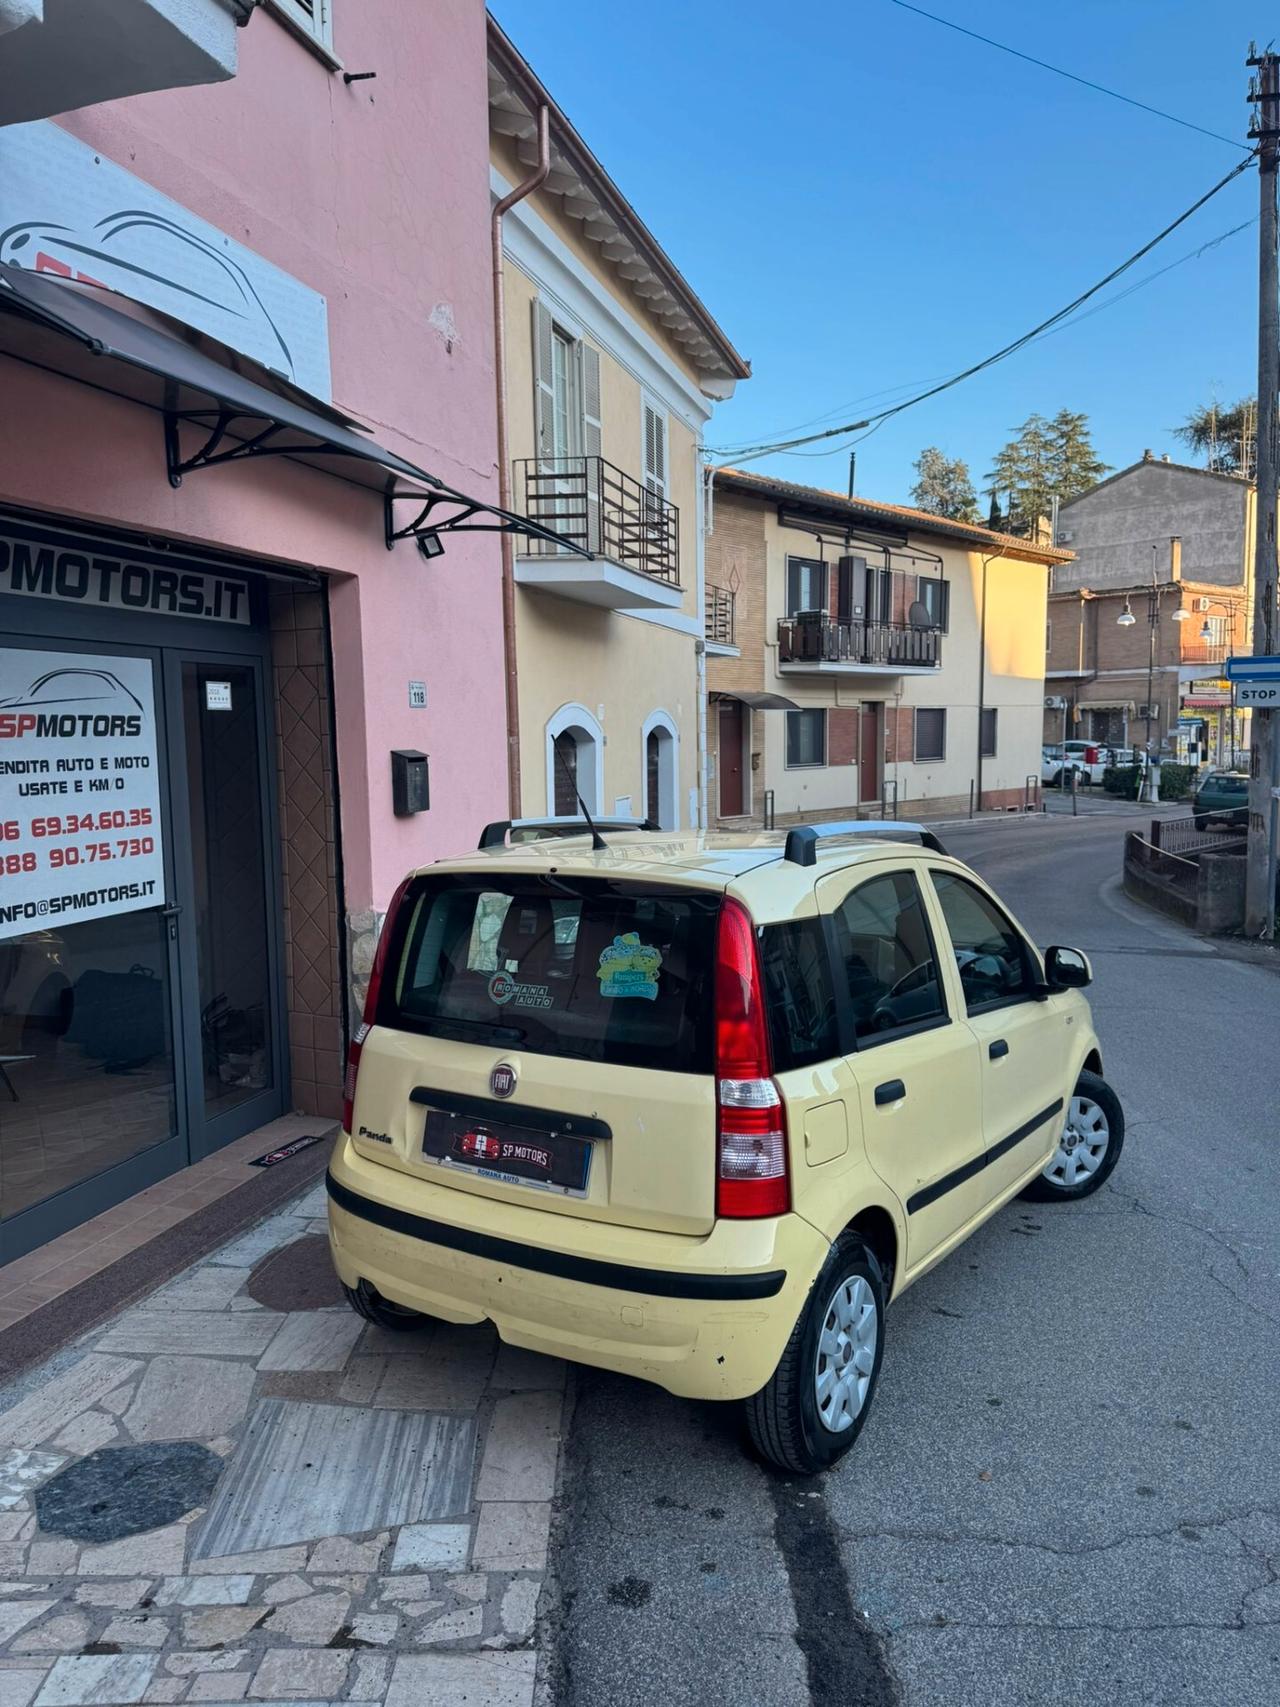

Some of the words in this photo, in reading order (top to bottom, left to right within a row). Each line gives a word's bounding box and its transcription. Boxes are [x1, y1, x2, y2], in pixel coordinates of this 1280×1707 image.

[1241, 690, 1277, 700] STOP
[0, 714, 141, 738] SPMOTORS
[56, 758, 94, 772] AUTO
[100, 757, 108, 770] E
[114, 756, 150, 769] MOTO
[18, 780, 68, 797] USATE
[74, 780, 83, 793] E
[0, 820, 20, 841] 6
[31, 807, 153, 838] 69.34.60.35
[49, 837, 154, 868] 90.75.730
[496, 983, 545, 995] ROMANA
[518, 996, 551, 1007] AUTO
[495, 1073, 510, 1089] FIAT
[359, 1126, 392, 1145] Panda
[502, 1144, 514, 1157] SP
[514, 1146, 548, 1166] MOTORS
